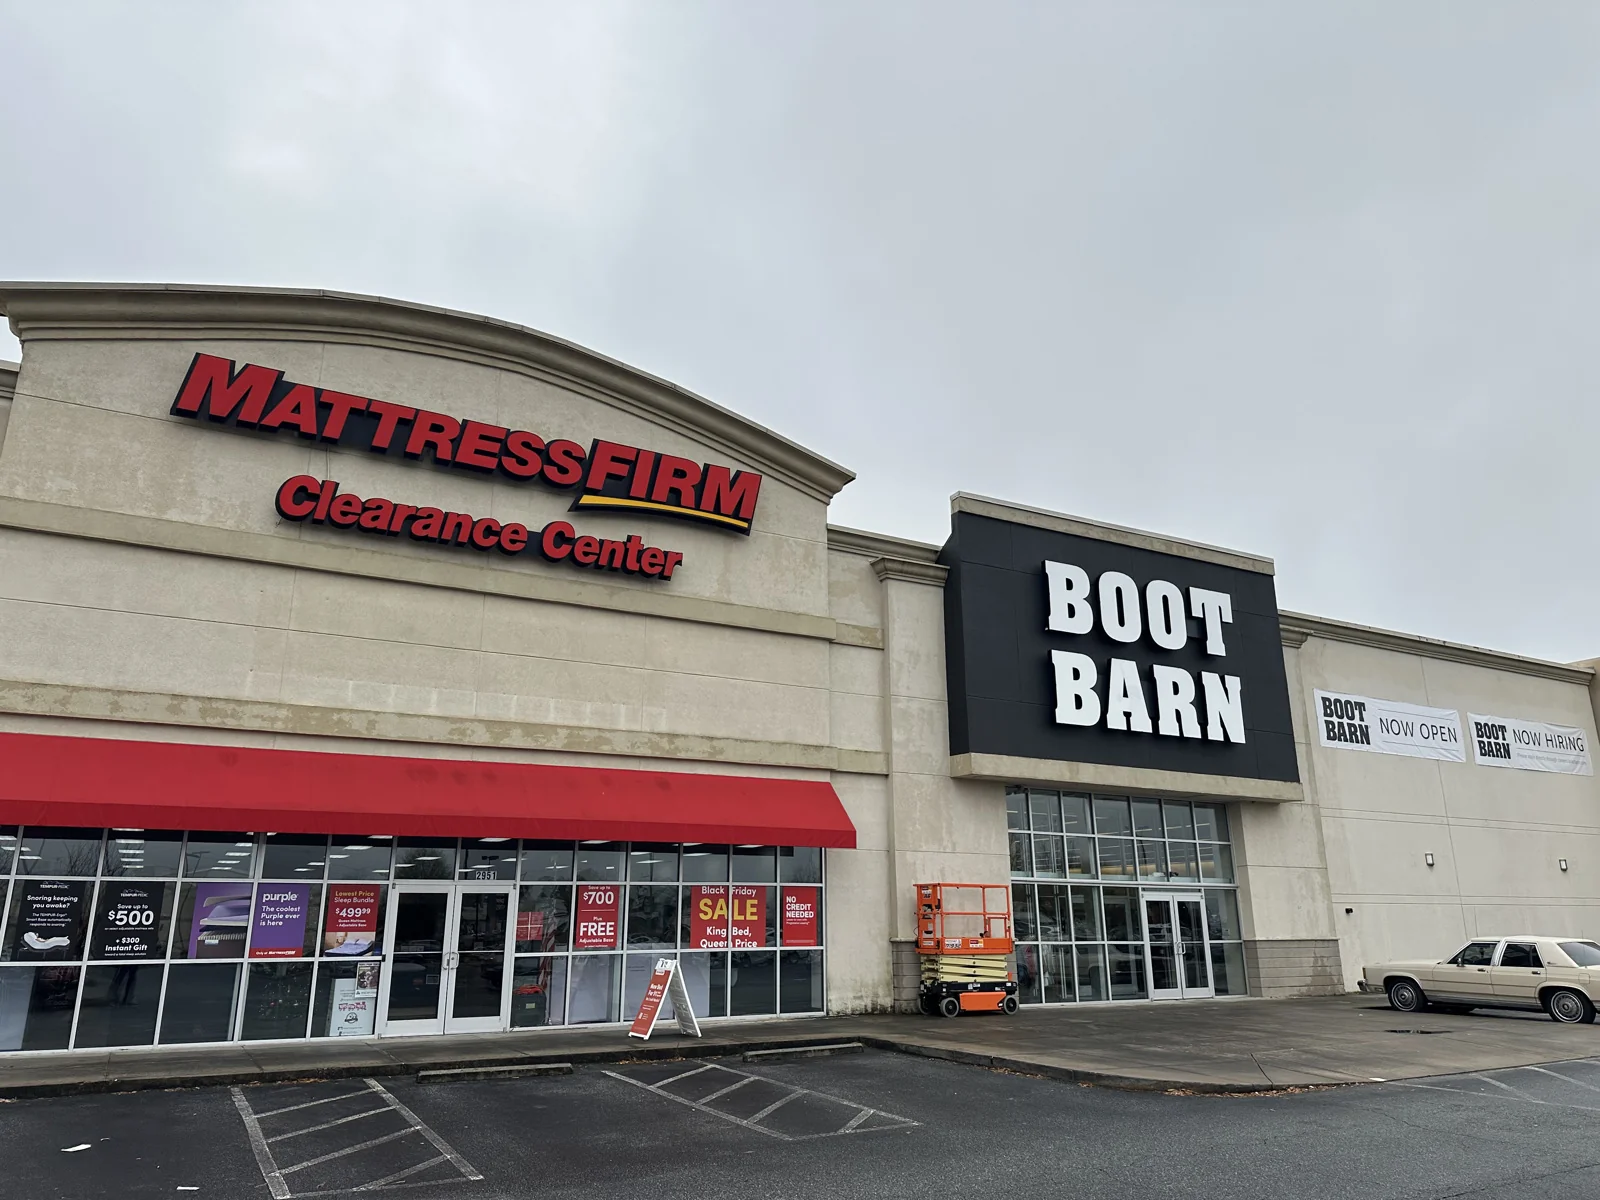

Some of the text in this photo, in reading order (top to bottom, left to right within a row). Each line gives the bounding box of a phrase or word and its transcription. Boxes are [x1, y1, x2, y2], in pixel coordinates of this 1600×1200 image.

[276, 474, 683, 580] Clearance Center
[1045, 559, 1233, 657] BOOT
[1051, 649, 1246, 744] BARN
[1321, 696, 1366, 722] BOOT
[1324, 719, 1371, 745] BARN
[1380, 717, 1458, 743] NOW OPEN
[1474, 721, 1507, 741] BOOT
[1512, 728, 1585, 752] NOW HIRING
[1477, 739, 1511, 760] BARN
[476, 871, 496, 880] 2951
[262, 892, 298, 902] purple
[583, 892, 614, 904] $700
[702, 886, 756, 897] Black Friday
[108, 910, 154, 926] $500
[699, 898, 758, 920] SALE
[580, 922, 614, 936] FREE
[706, 927, 752, 937] King Bed,
[735, 939, 758, 948] Price
